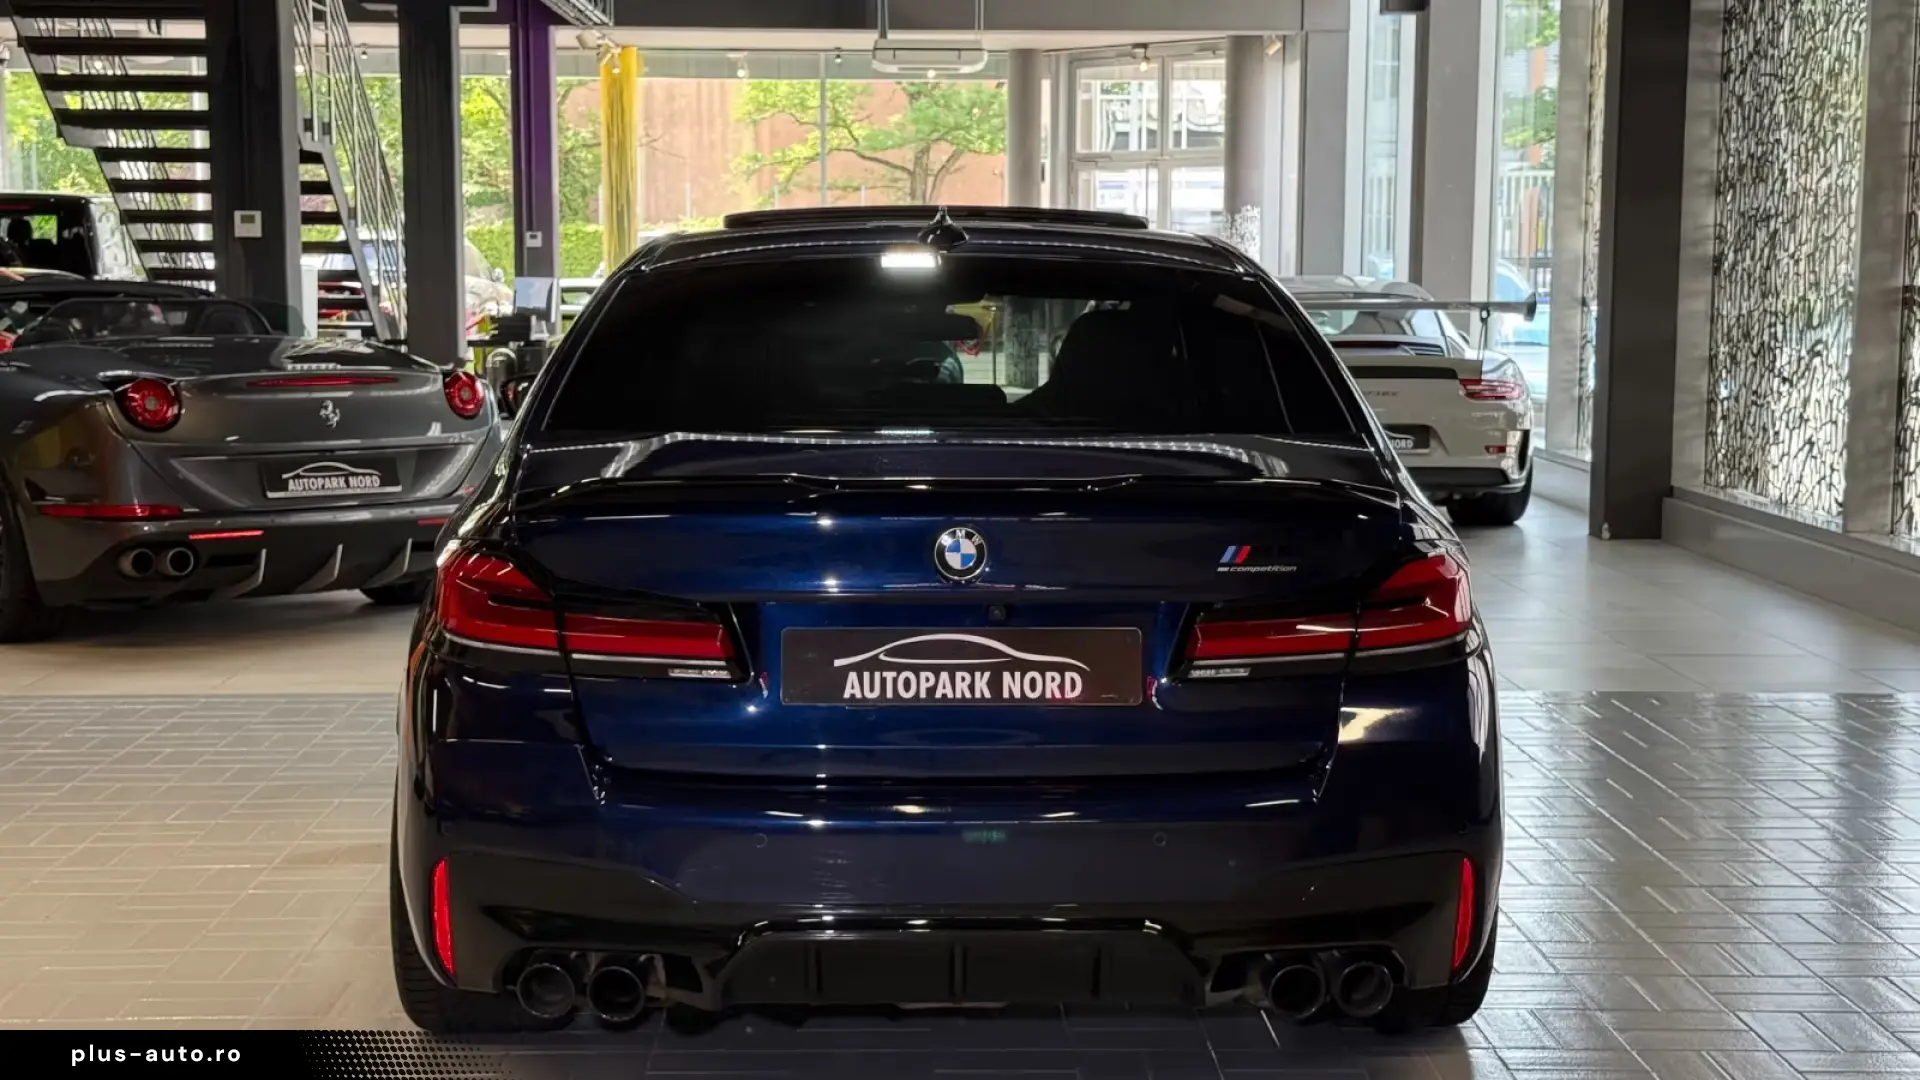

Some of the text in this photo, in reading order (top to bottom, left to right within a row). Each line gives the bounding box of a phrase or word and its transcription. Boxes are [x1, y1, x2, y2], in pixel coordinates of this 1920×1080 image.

[288, 475, 381, 492] AUTOPARK NORD
[941, 529, 983, 546] BMW
[1229, 564, 1298, 573] competition
[843, 670, 1084, 700] AUTOPARK NORD
